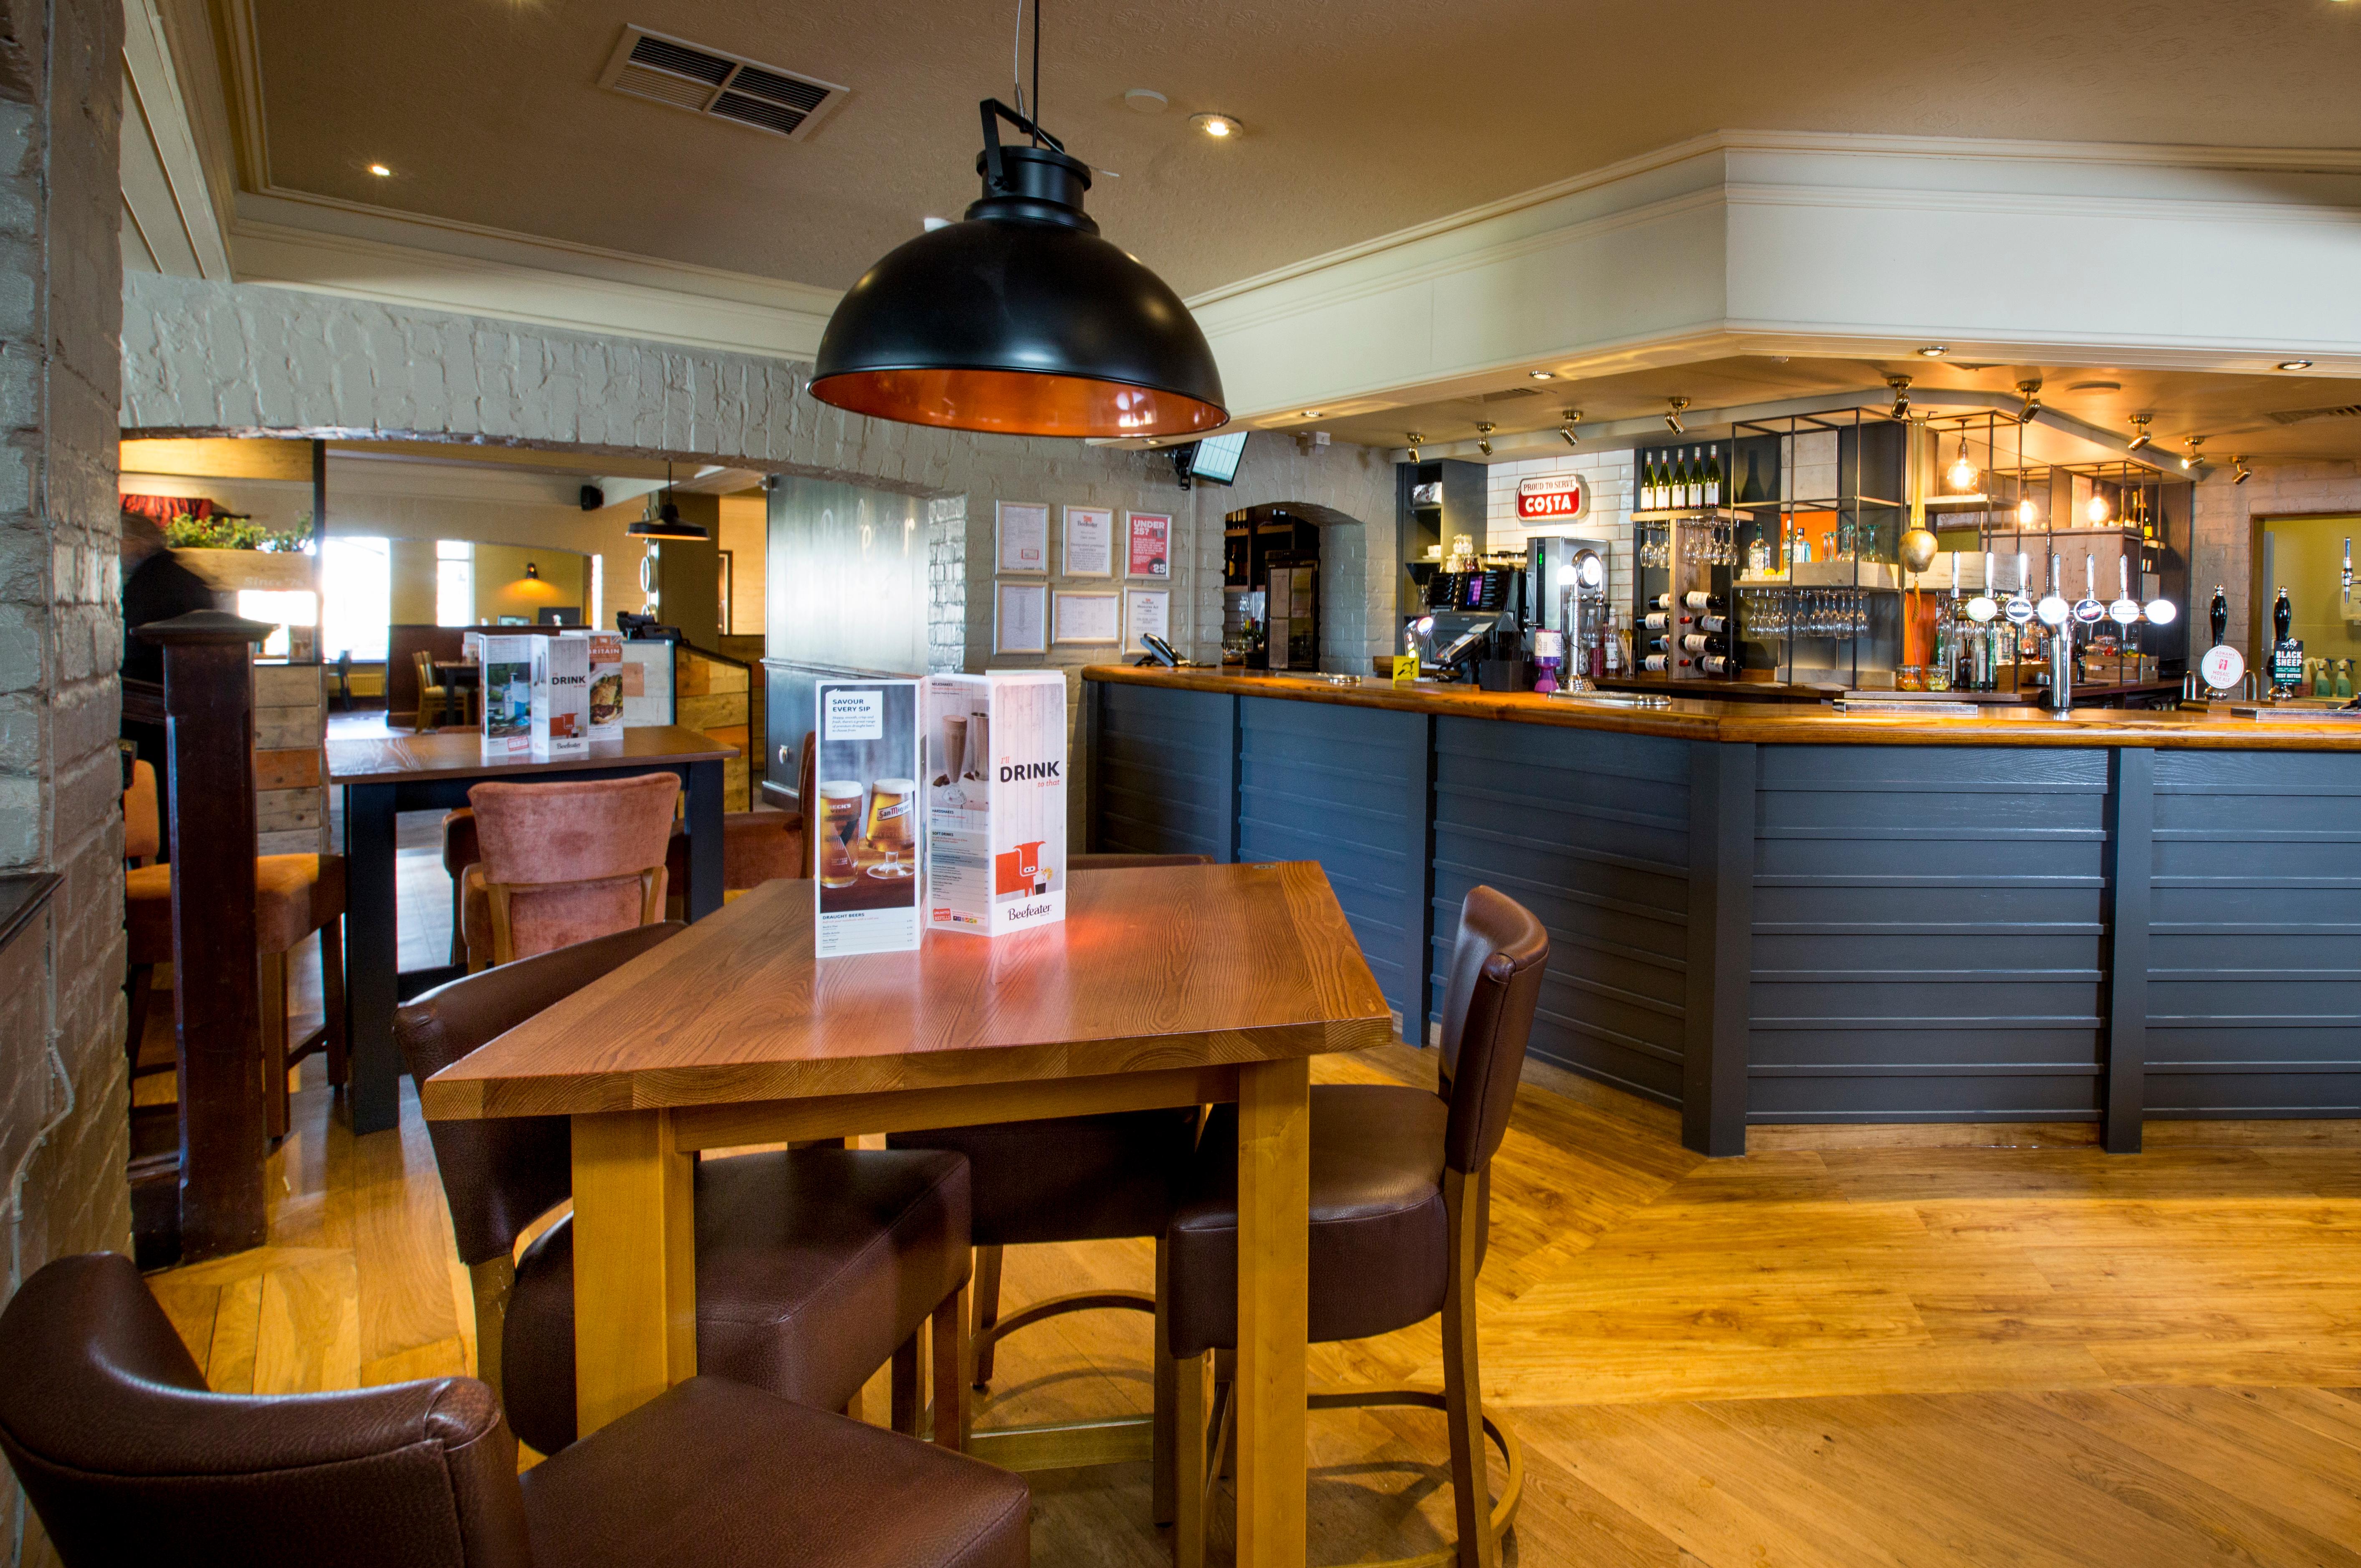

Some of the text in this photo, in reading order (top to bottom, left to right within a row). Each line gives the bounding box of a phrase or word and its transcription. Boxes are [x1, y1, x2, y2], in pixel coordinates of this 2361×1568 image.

[1524, 483, 1544, 491] PROUD
[1555, 480, 1574, 489] SERVE
[1525, 495, 1571, 513] COSTA
[1134, 520, 1165, 529] UNDER
[1153, 564, 1166, 574] 25
[552, 675, 586, 685] DRINK
[1000, 761, 1060, 783] DRINK
[877, 802, 911, 820] San Miguel
[1008, 904, 1052, 921] Beefeater
